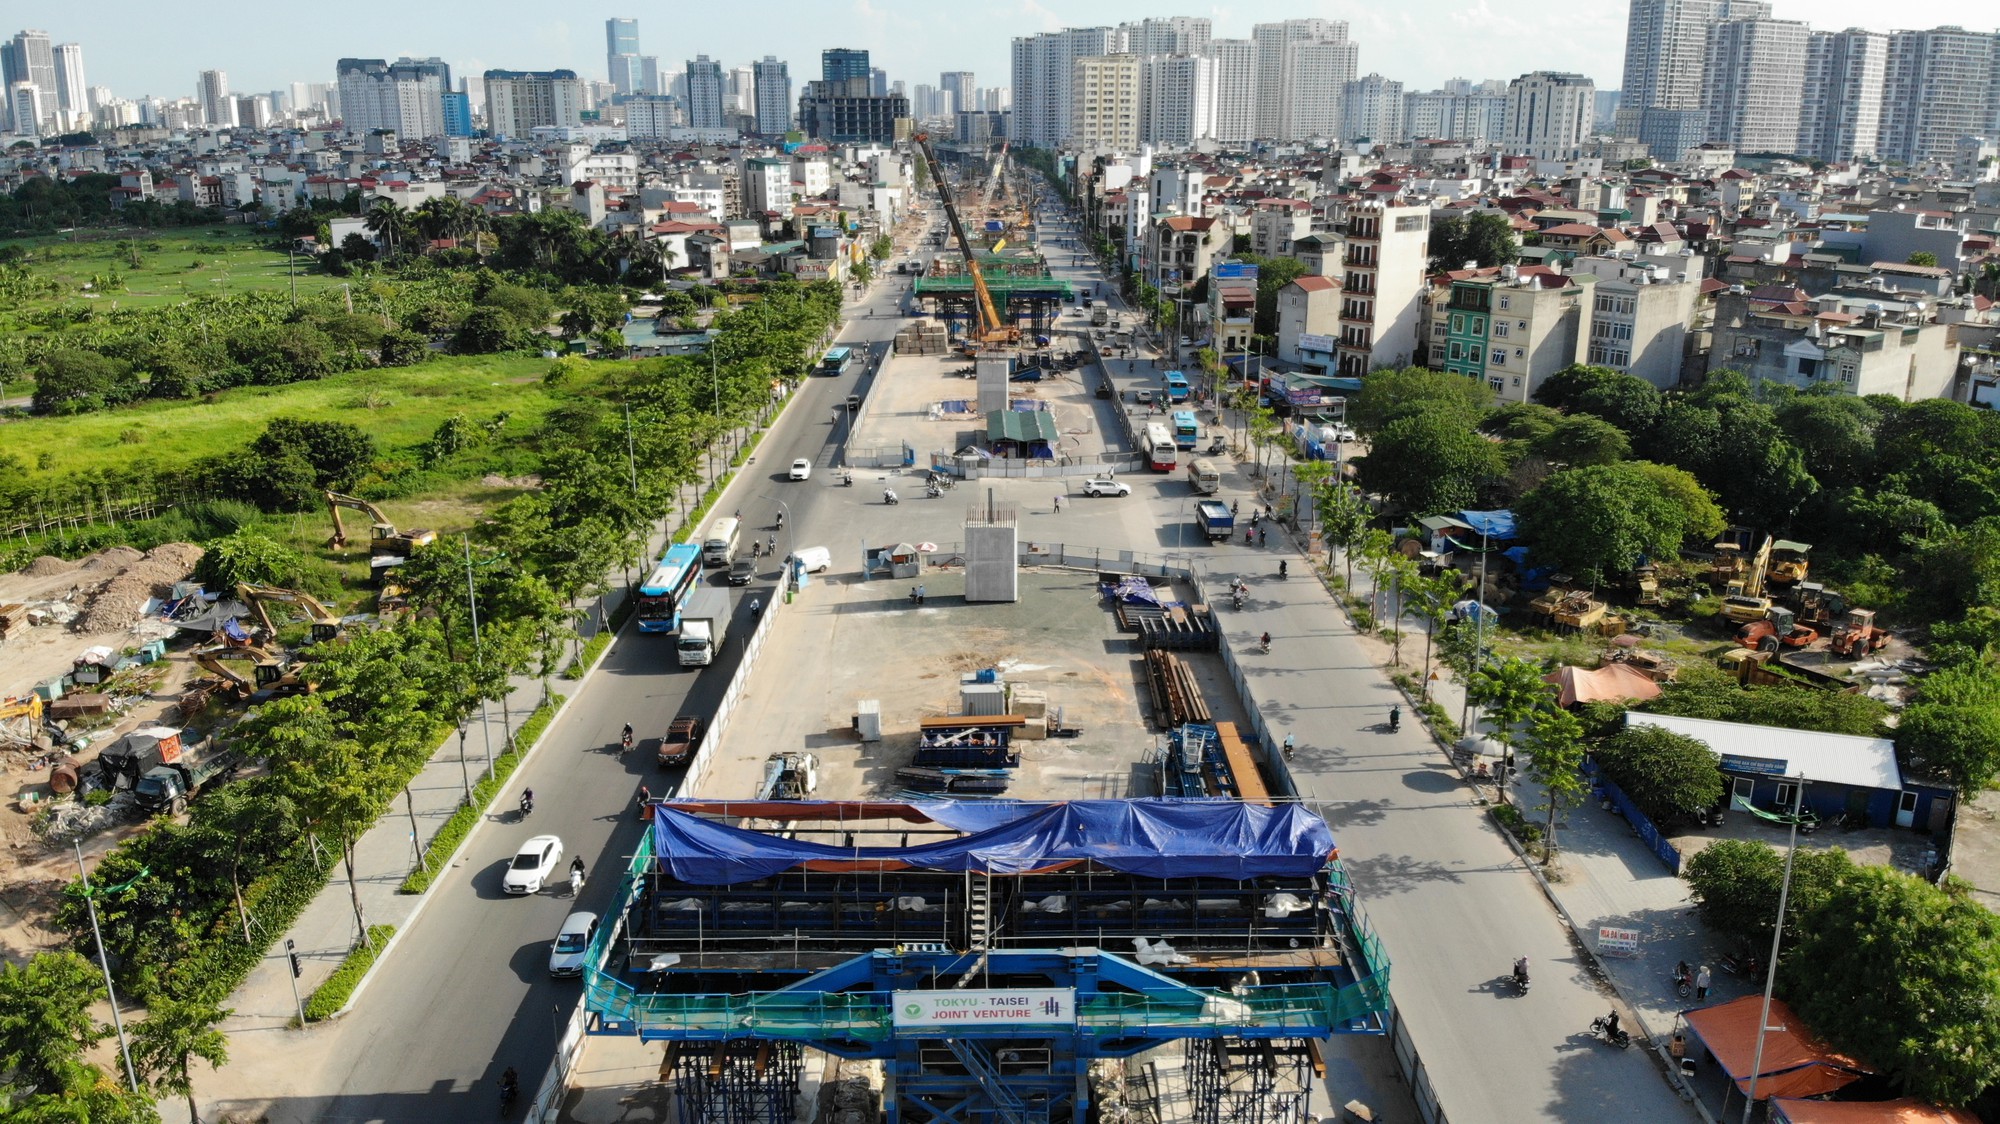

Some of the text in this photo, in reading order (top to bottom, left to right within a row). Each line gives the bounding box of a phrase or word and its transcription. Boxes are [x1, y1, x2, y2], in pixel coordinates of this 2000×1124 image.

[934, 998, 978, 1007] TOKYU
[989, 997, 1029, 1006] TAISEI
[932, 1009, 1031, 1019] JOINT VENTURE
